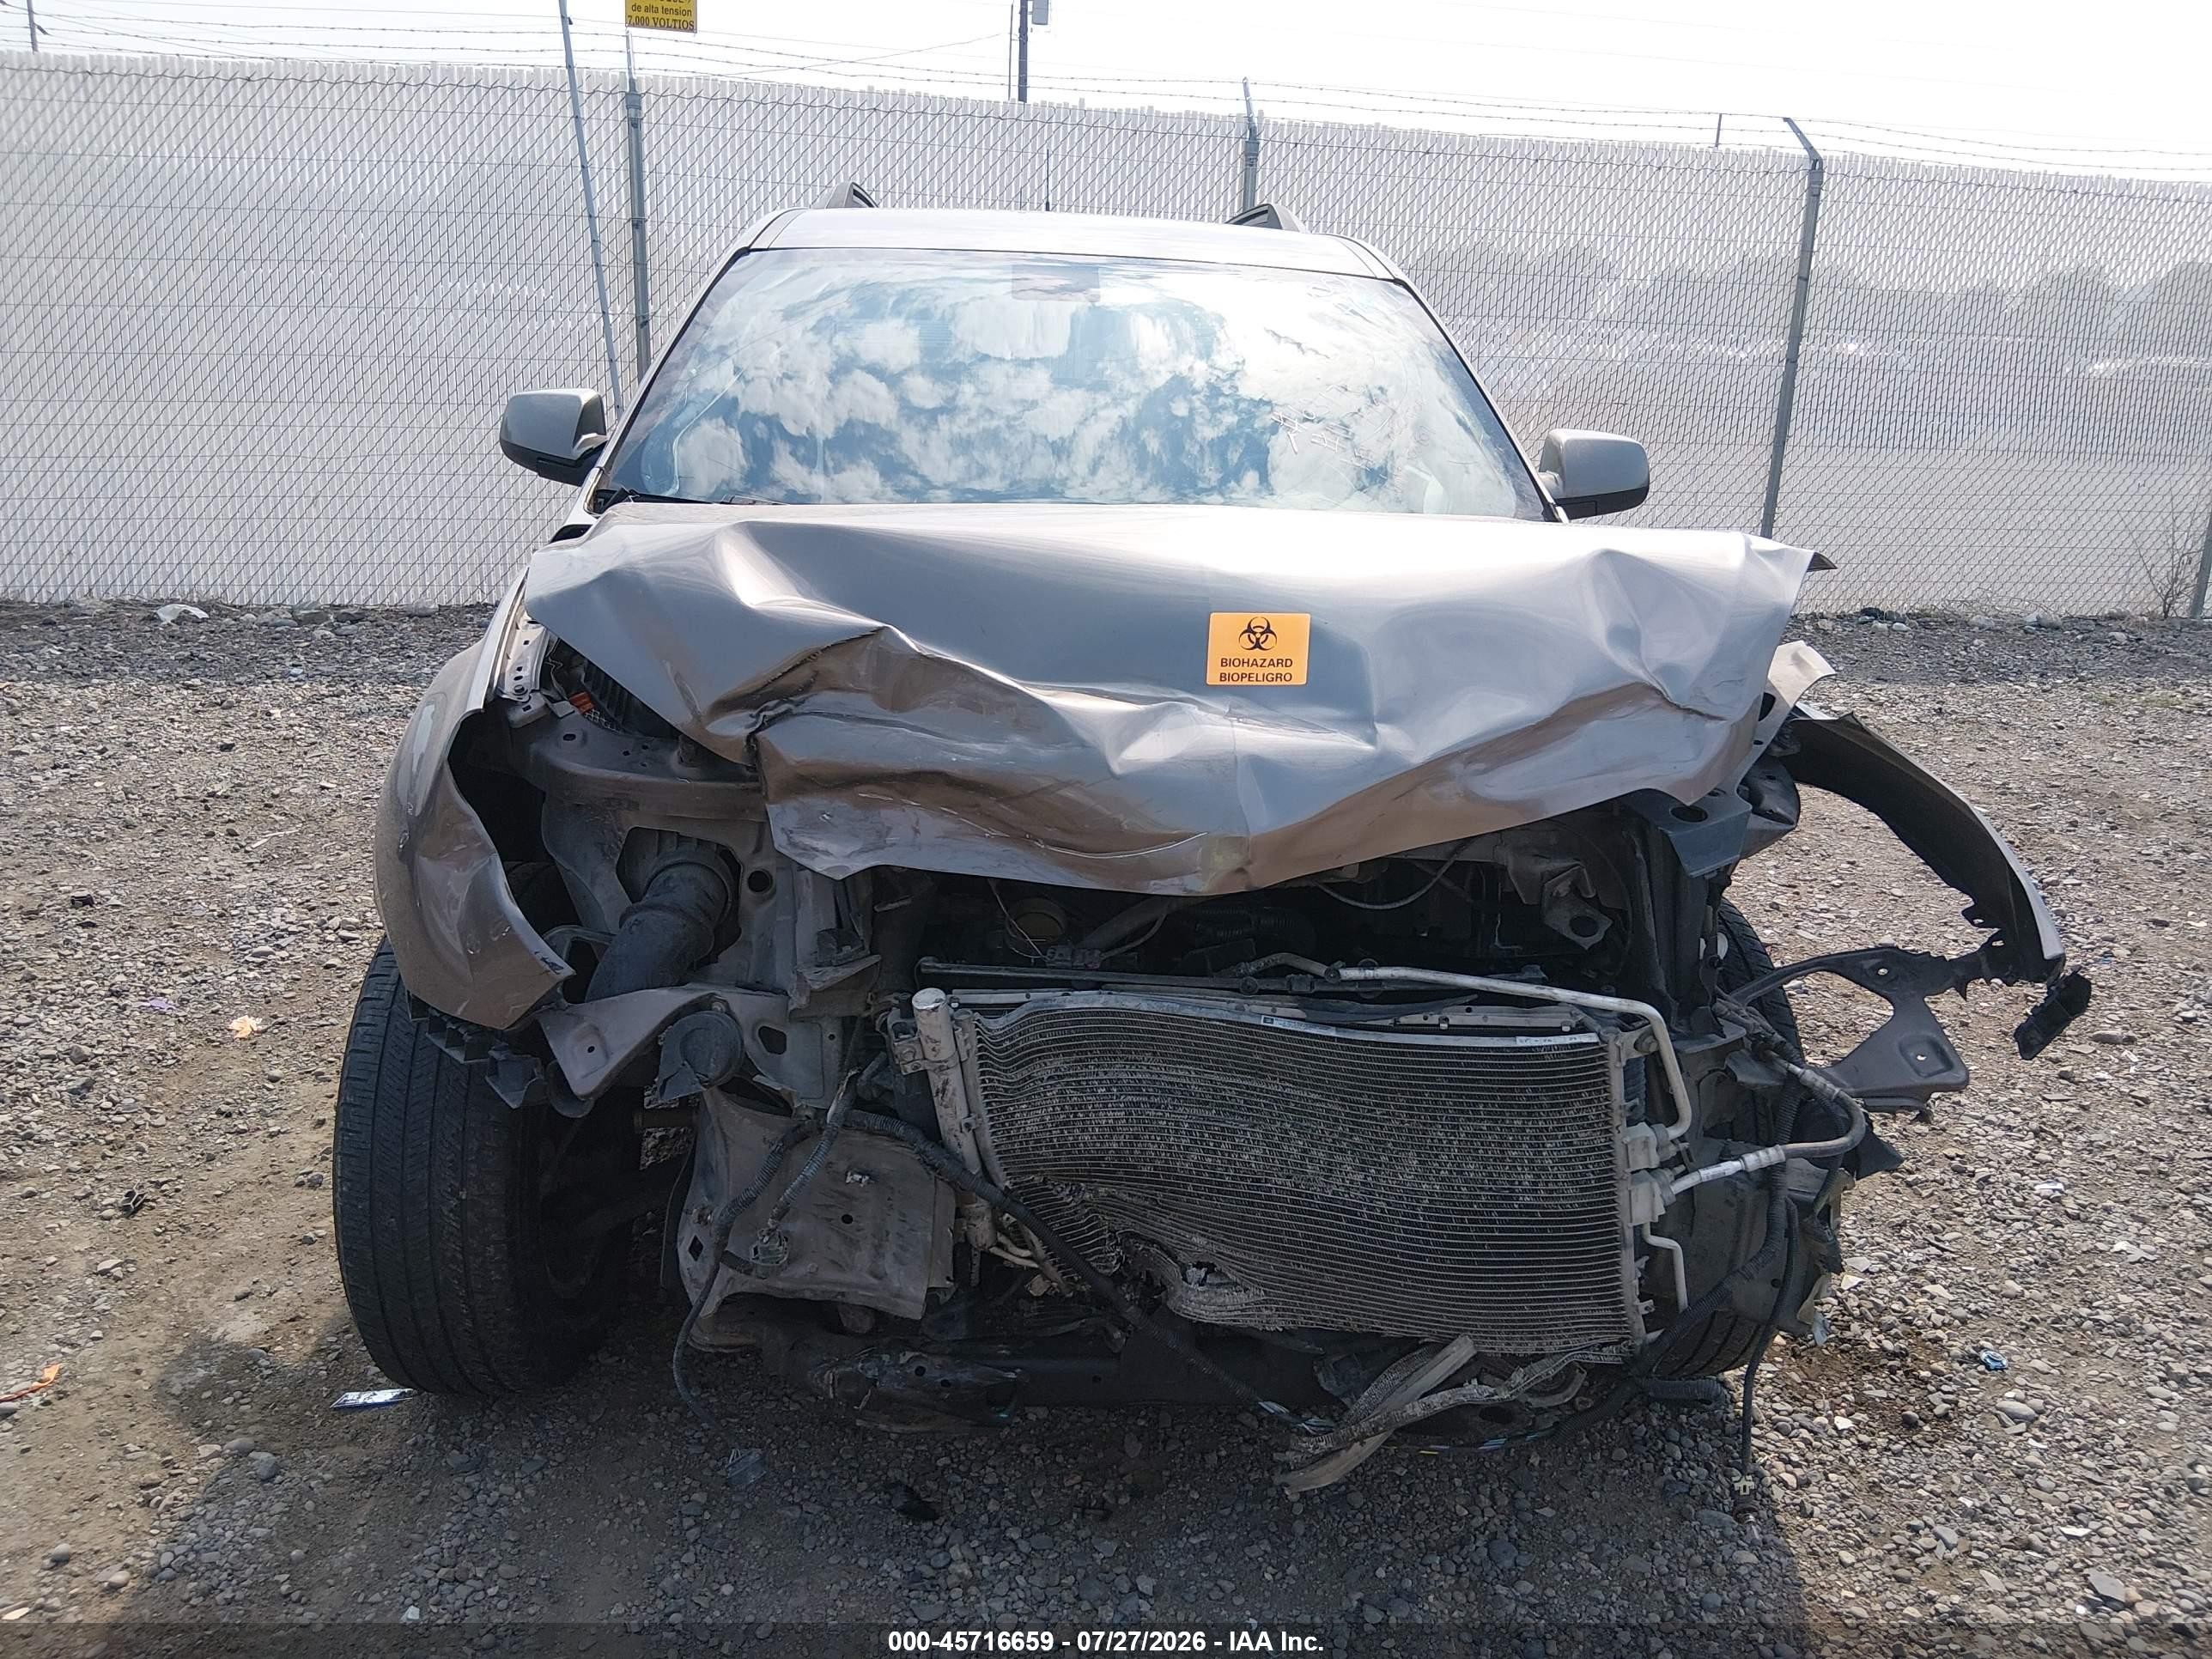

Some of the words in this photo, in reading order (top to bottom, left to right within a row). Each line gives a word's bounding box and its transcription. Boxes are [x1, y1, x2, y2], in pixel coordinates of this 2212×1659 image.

[632, 3, 641, 12] de
[644, 4, 659, 14] alta
[661, 5, 692, 17] tension
[653, 17, 695, 30] VOLTIOS
[1220, 658, 1293, 668] BIOHAZARD
[1219, 672, 1292, 683] BIOPELIGRO
